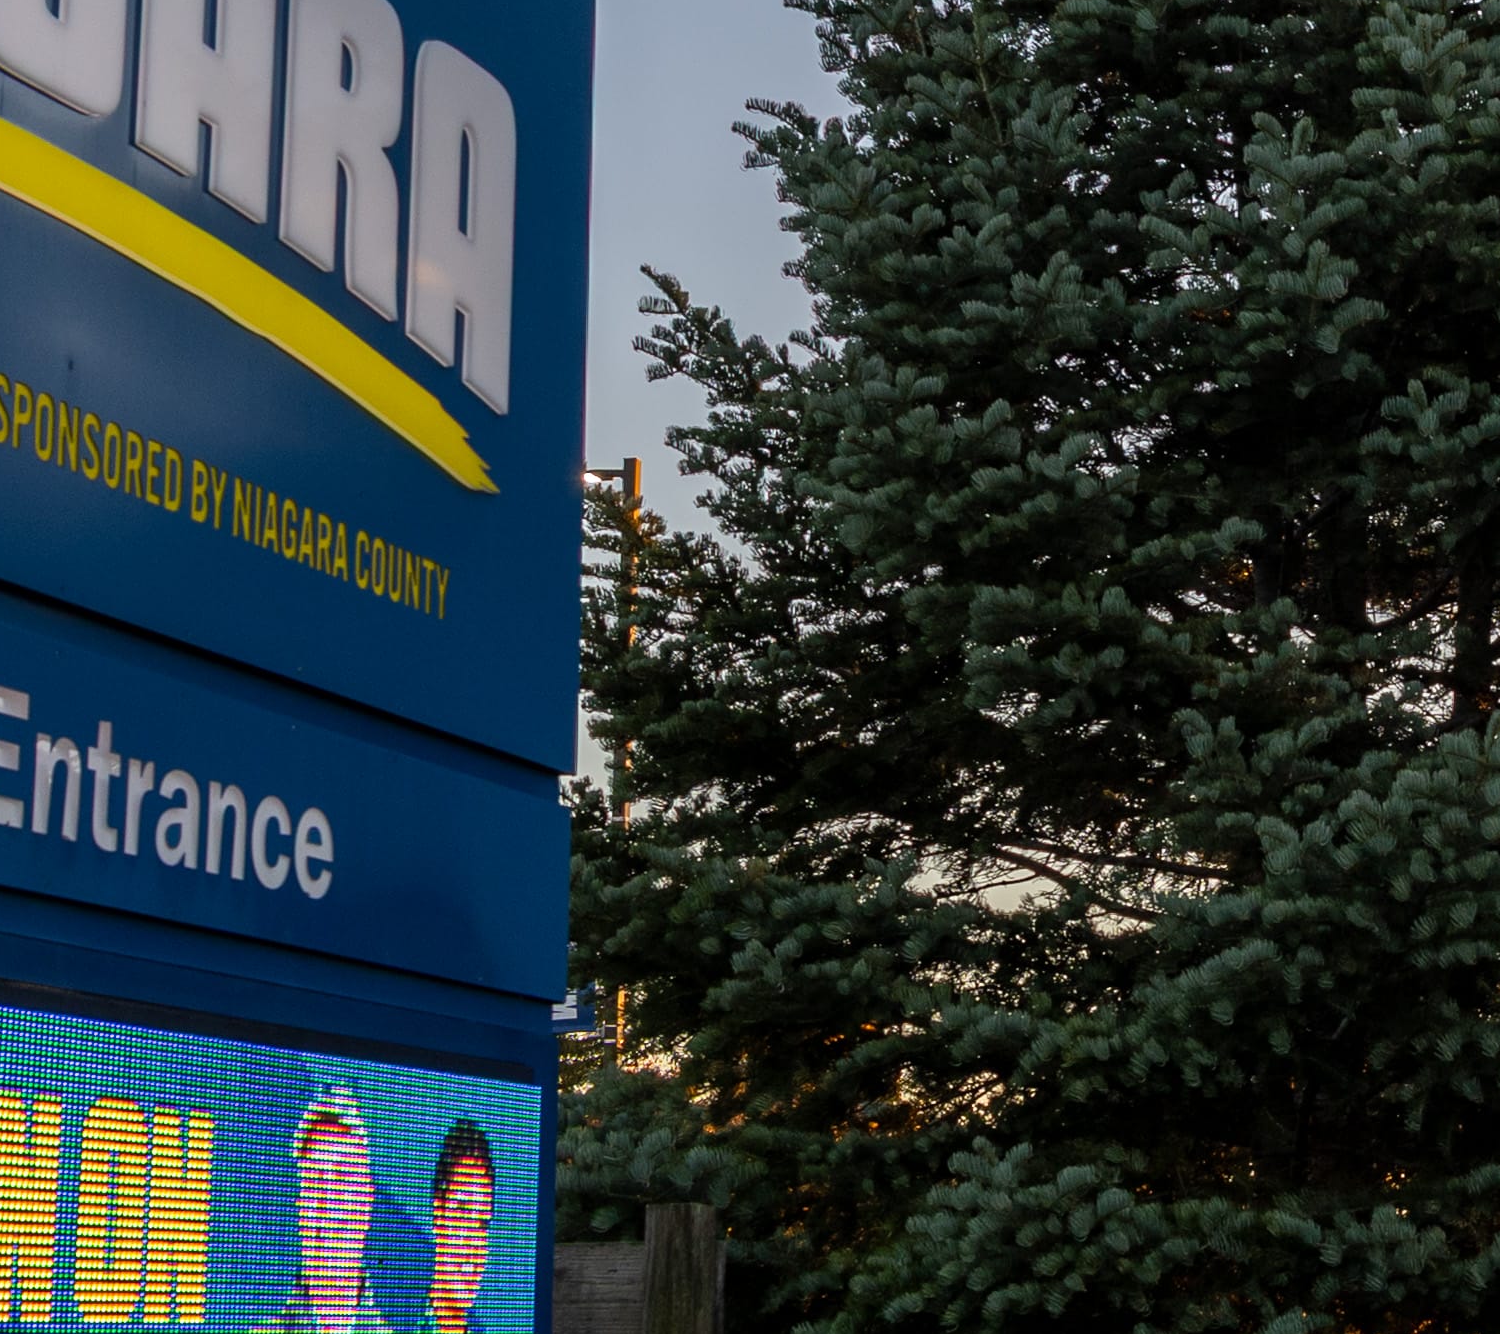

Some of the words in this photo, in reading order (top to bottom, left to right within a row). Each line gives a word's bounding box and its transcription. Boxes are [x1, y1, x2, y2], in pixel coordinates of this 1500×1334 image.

[191, 458, 227, 533] BY
[232, 477, 349, 579] NIAGARA
[354, 528, 449, 620] COUNTY
[73, 1096, 215, 1325] ON
